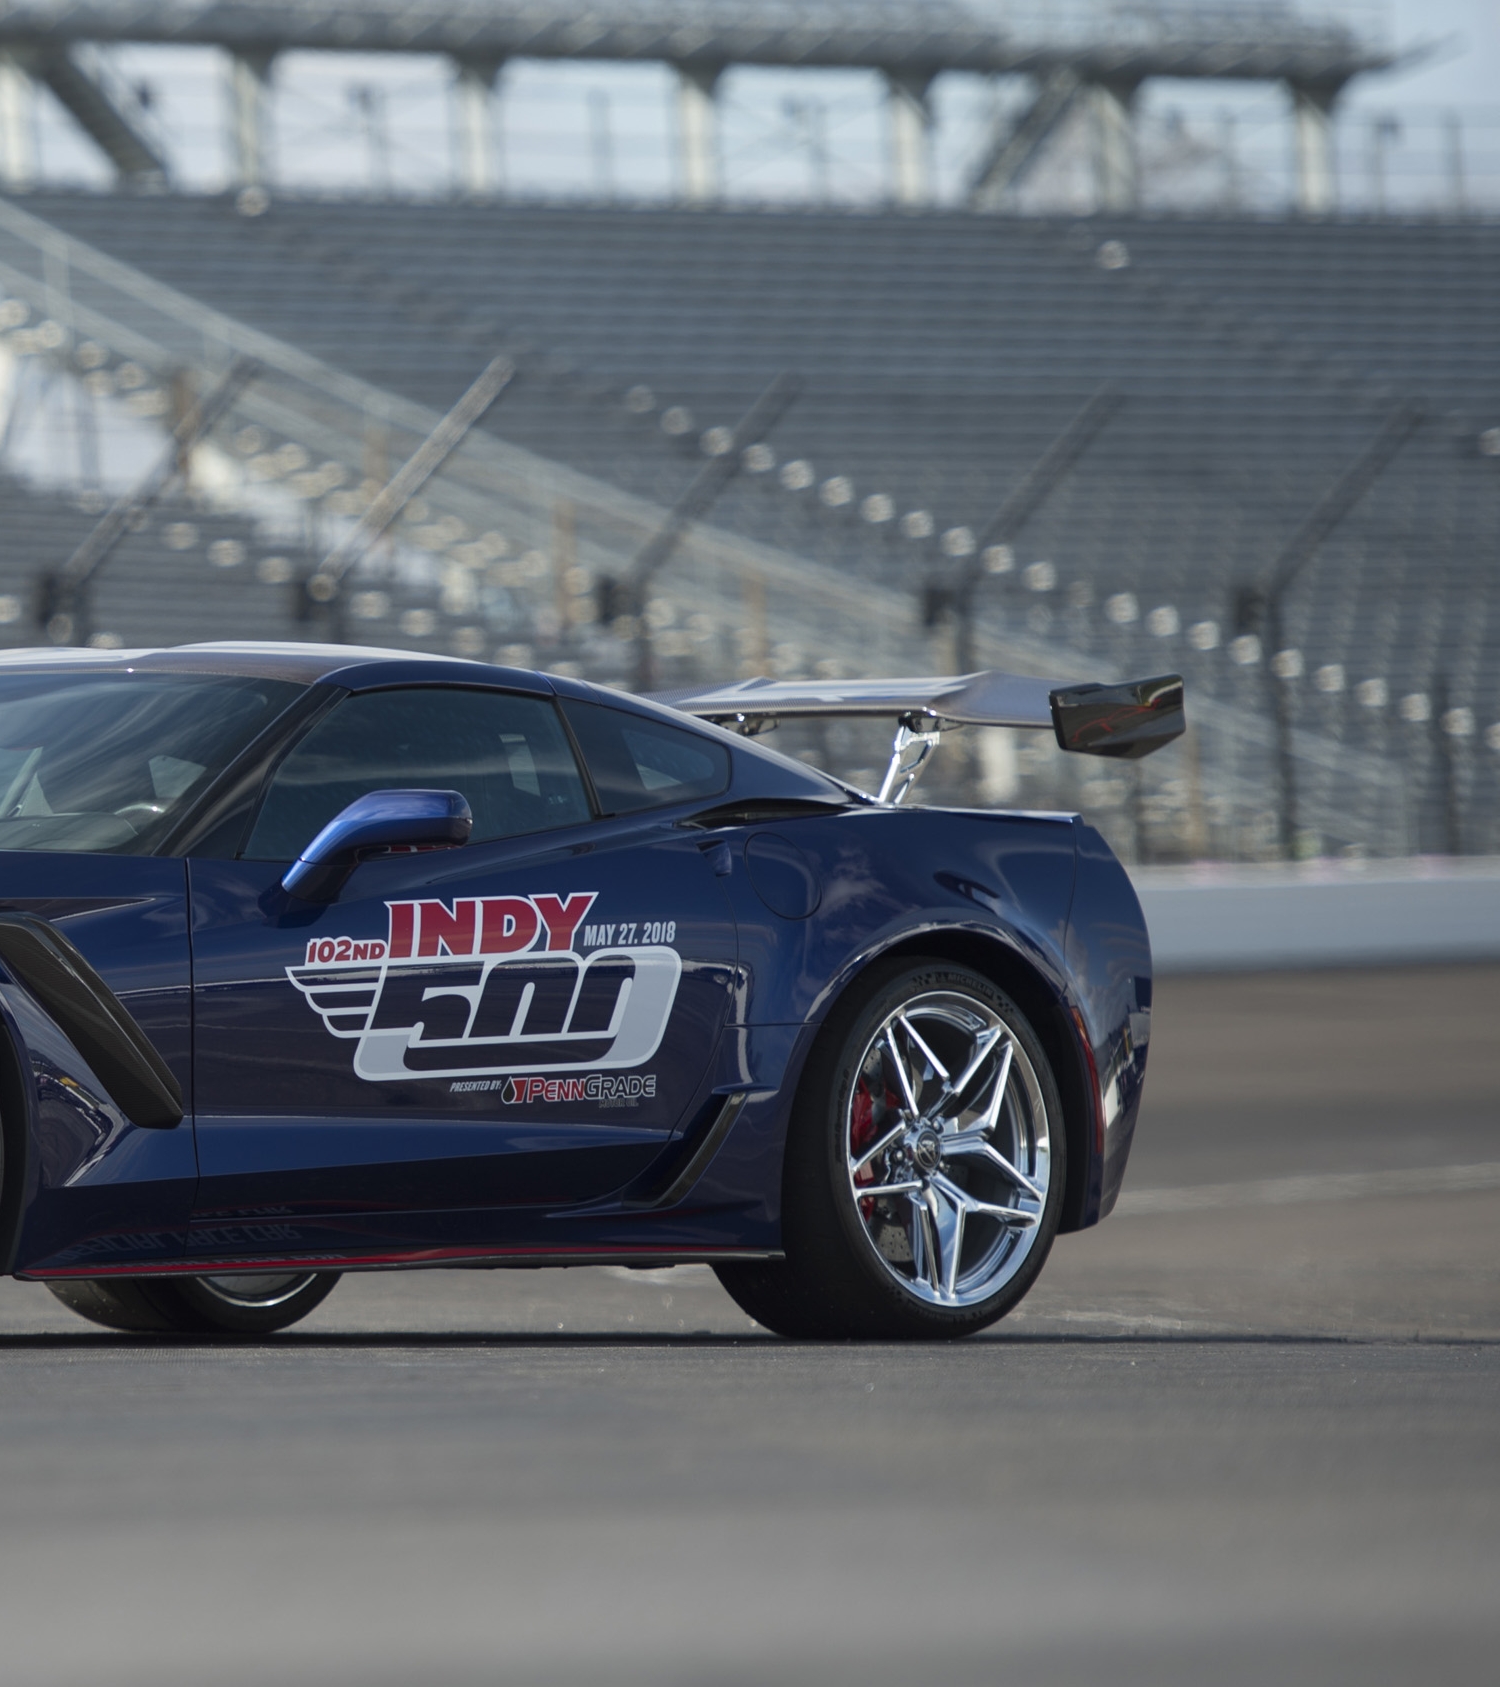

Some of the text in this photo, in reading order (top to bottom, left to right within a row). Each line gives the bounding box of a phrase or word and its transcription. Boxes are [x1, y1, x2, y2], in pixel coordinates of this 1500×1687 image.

[306, 892, 599, 964] 102ND INDY
[584, 924, 616, 947] MAY
[642, 921, 677, 944] 2018
[354, 946, 682, 1081] 500
[450, 1081, 490, 1093] PRESENTED
